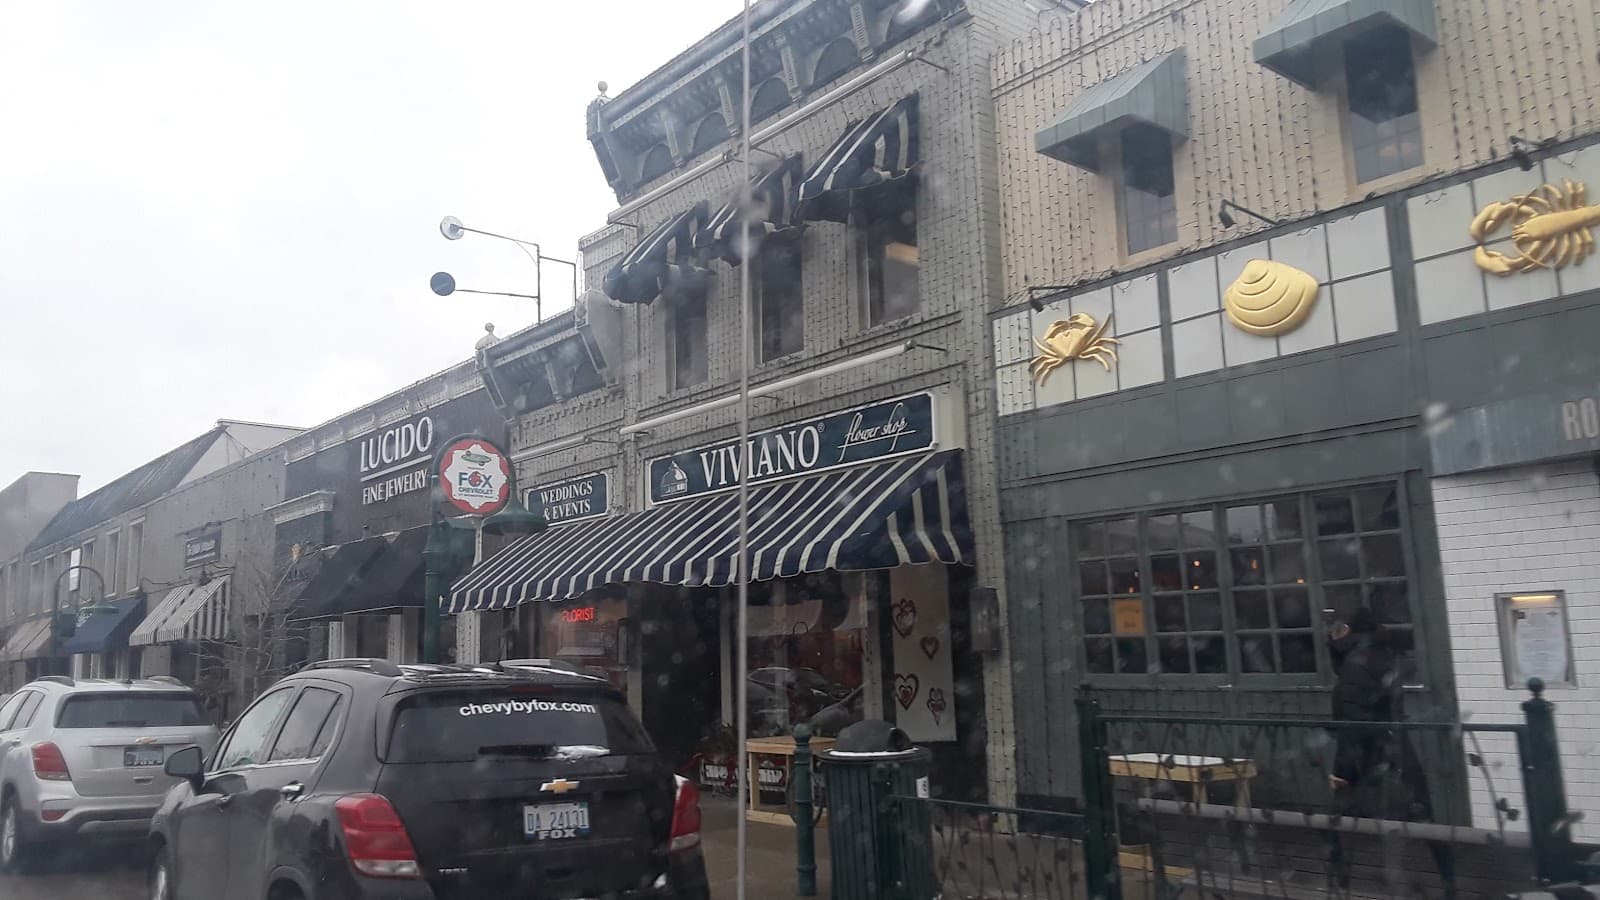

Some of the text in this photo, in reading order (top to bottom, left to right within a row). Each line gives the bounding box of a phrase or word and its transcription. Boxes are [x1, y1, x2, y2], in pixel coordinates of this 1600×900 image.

[1562, 396, 1600, 441] RO
[360, 416, 433, 472] LUCIDO
[838, 412, 880, 462] flower
[880, 402, 909, 452] shop
[362, 468, 429, 505] FINE JEWELRY
[458, 470, 493, 489] FOX
[540, 480, 593, 505] WEDDINGS
[543, 499, 591, 521] & EVENTS
[459, 699, 597, 716] chevybyfox.com
[538, 828, 577, 840] FOX
